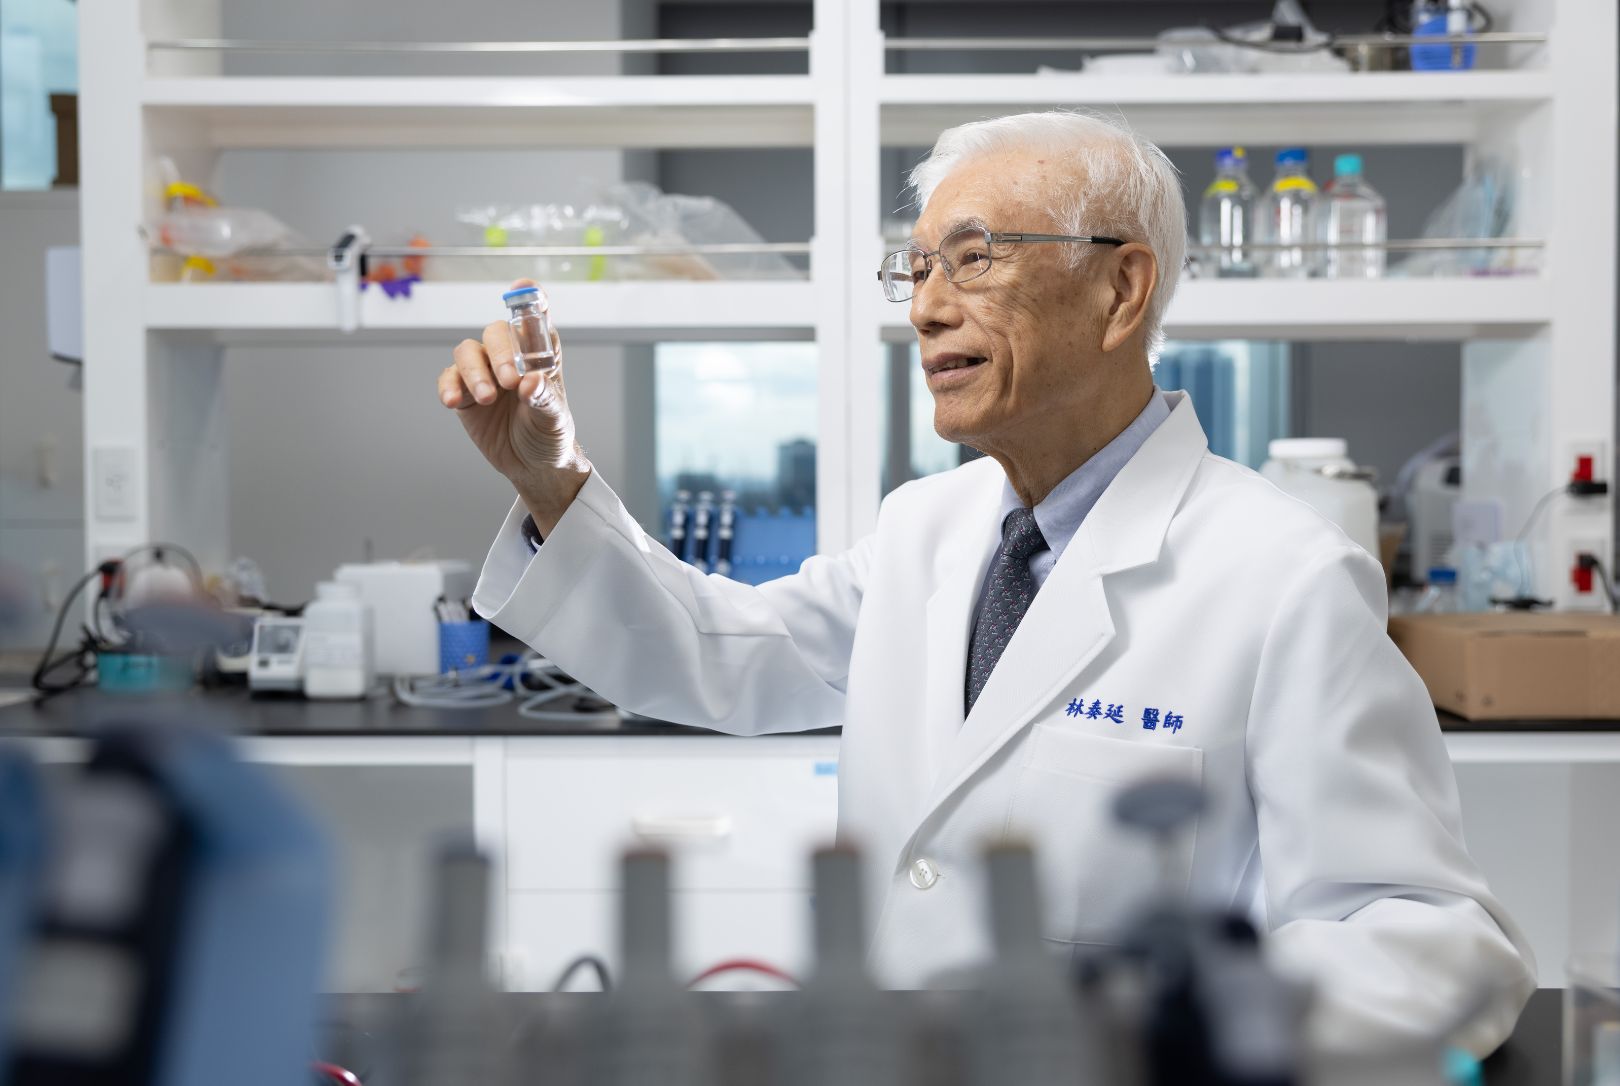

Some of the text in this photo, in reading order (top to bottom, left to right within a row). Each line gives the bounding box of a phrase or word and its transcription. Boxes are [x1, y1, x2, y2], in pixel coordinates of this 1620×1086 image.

[1065, 697, 1184, 734] 林奏延 醫師
